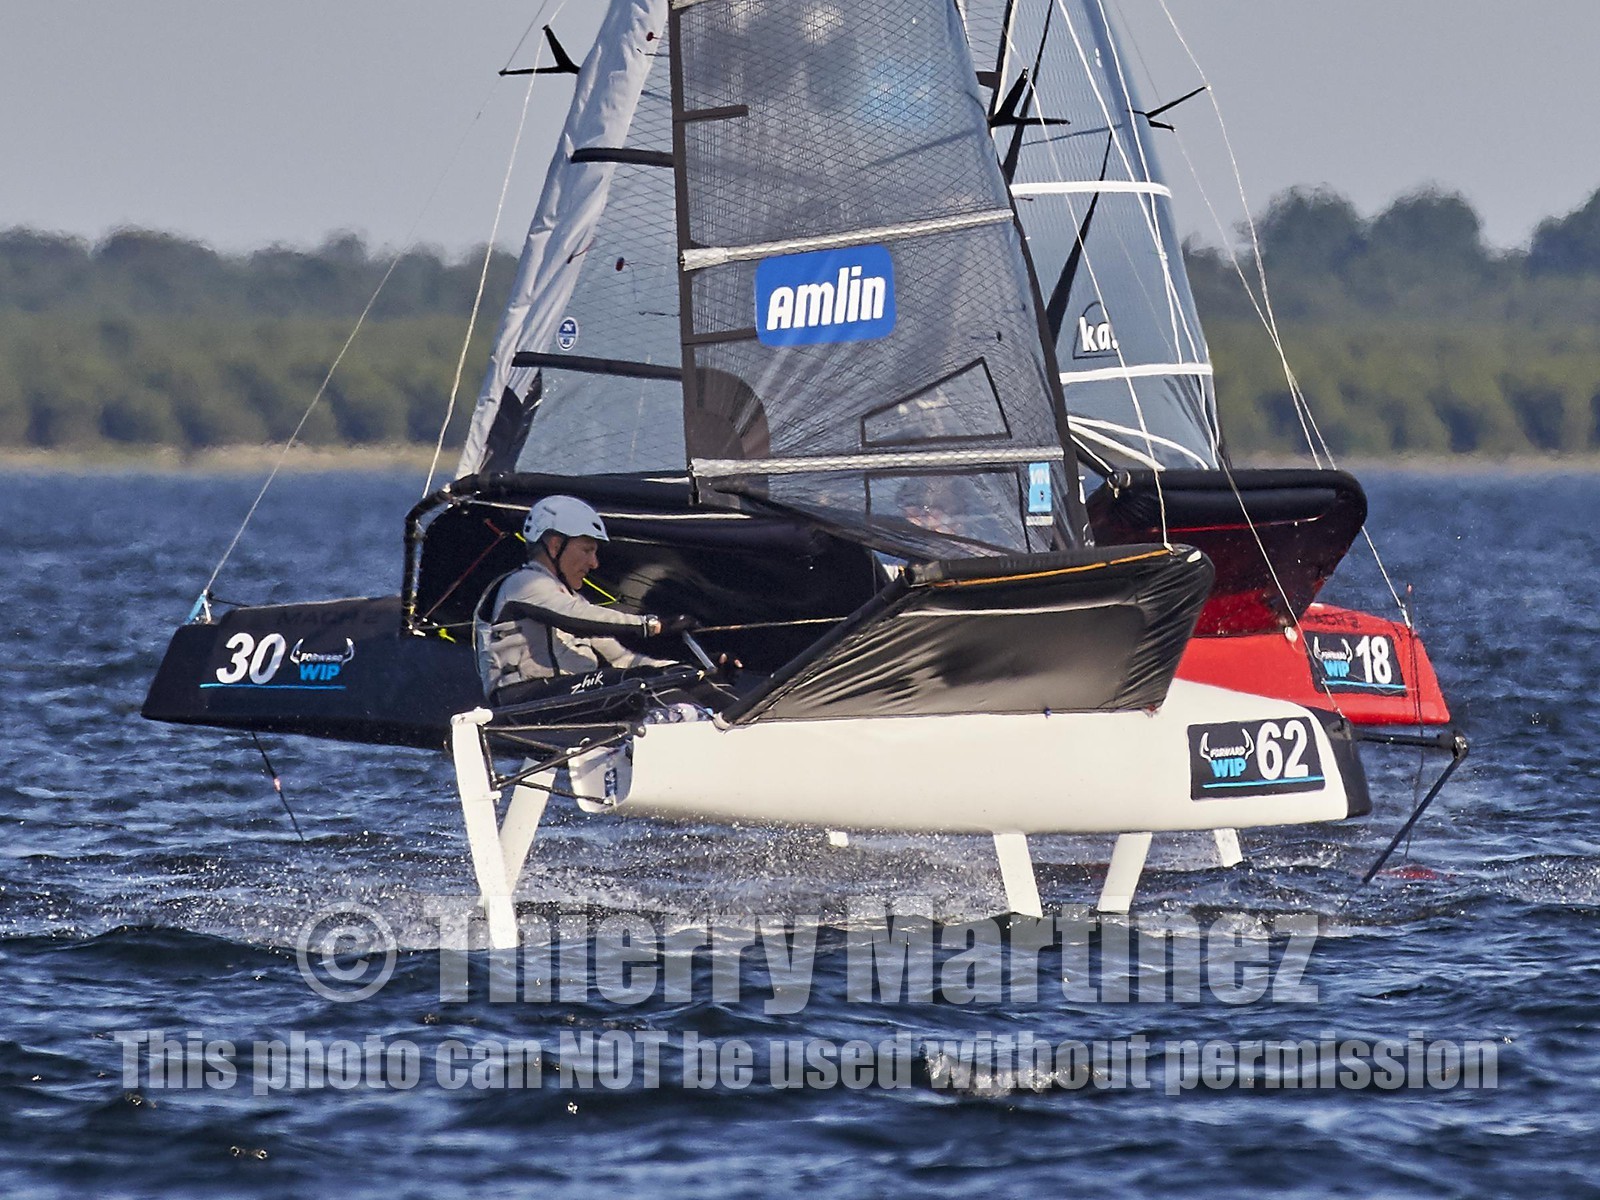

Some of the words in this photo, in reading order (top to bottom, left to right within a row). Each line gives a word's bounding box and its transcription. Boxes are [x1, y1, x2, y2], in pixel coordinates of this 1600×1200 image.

[216, 633, 286, 685] 30
[300, 663, 340, 681] WIP
[1356, 636, 1392, 684] 18
[1210, 757, 1247, 778] WIP
[1256, 720, 1309, 780] 62
